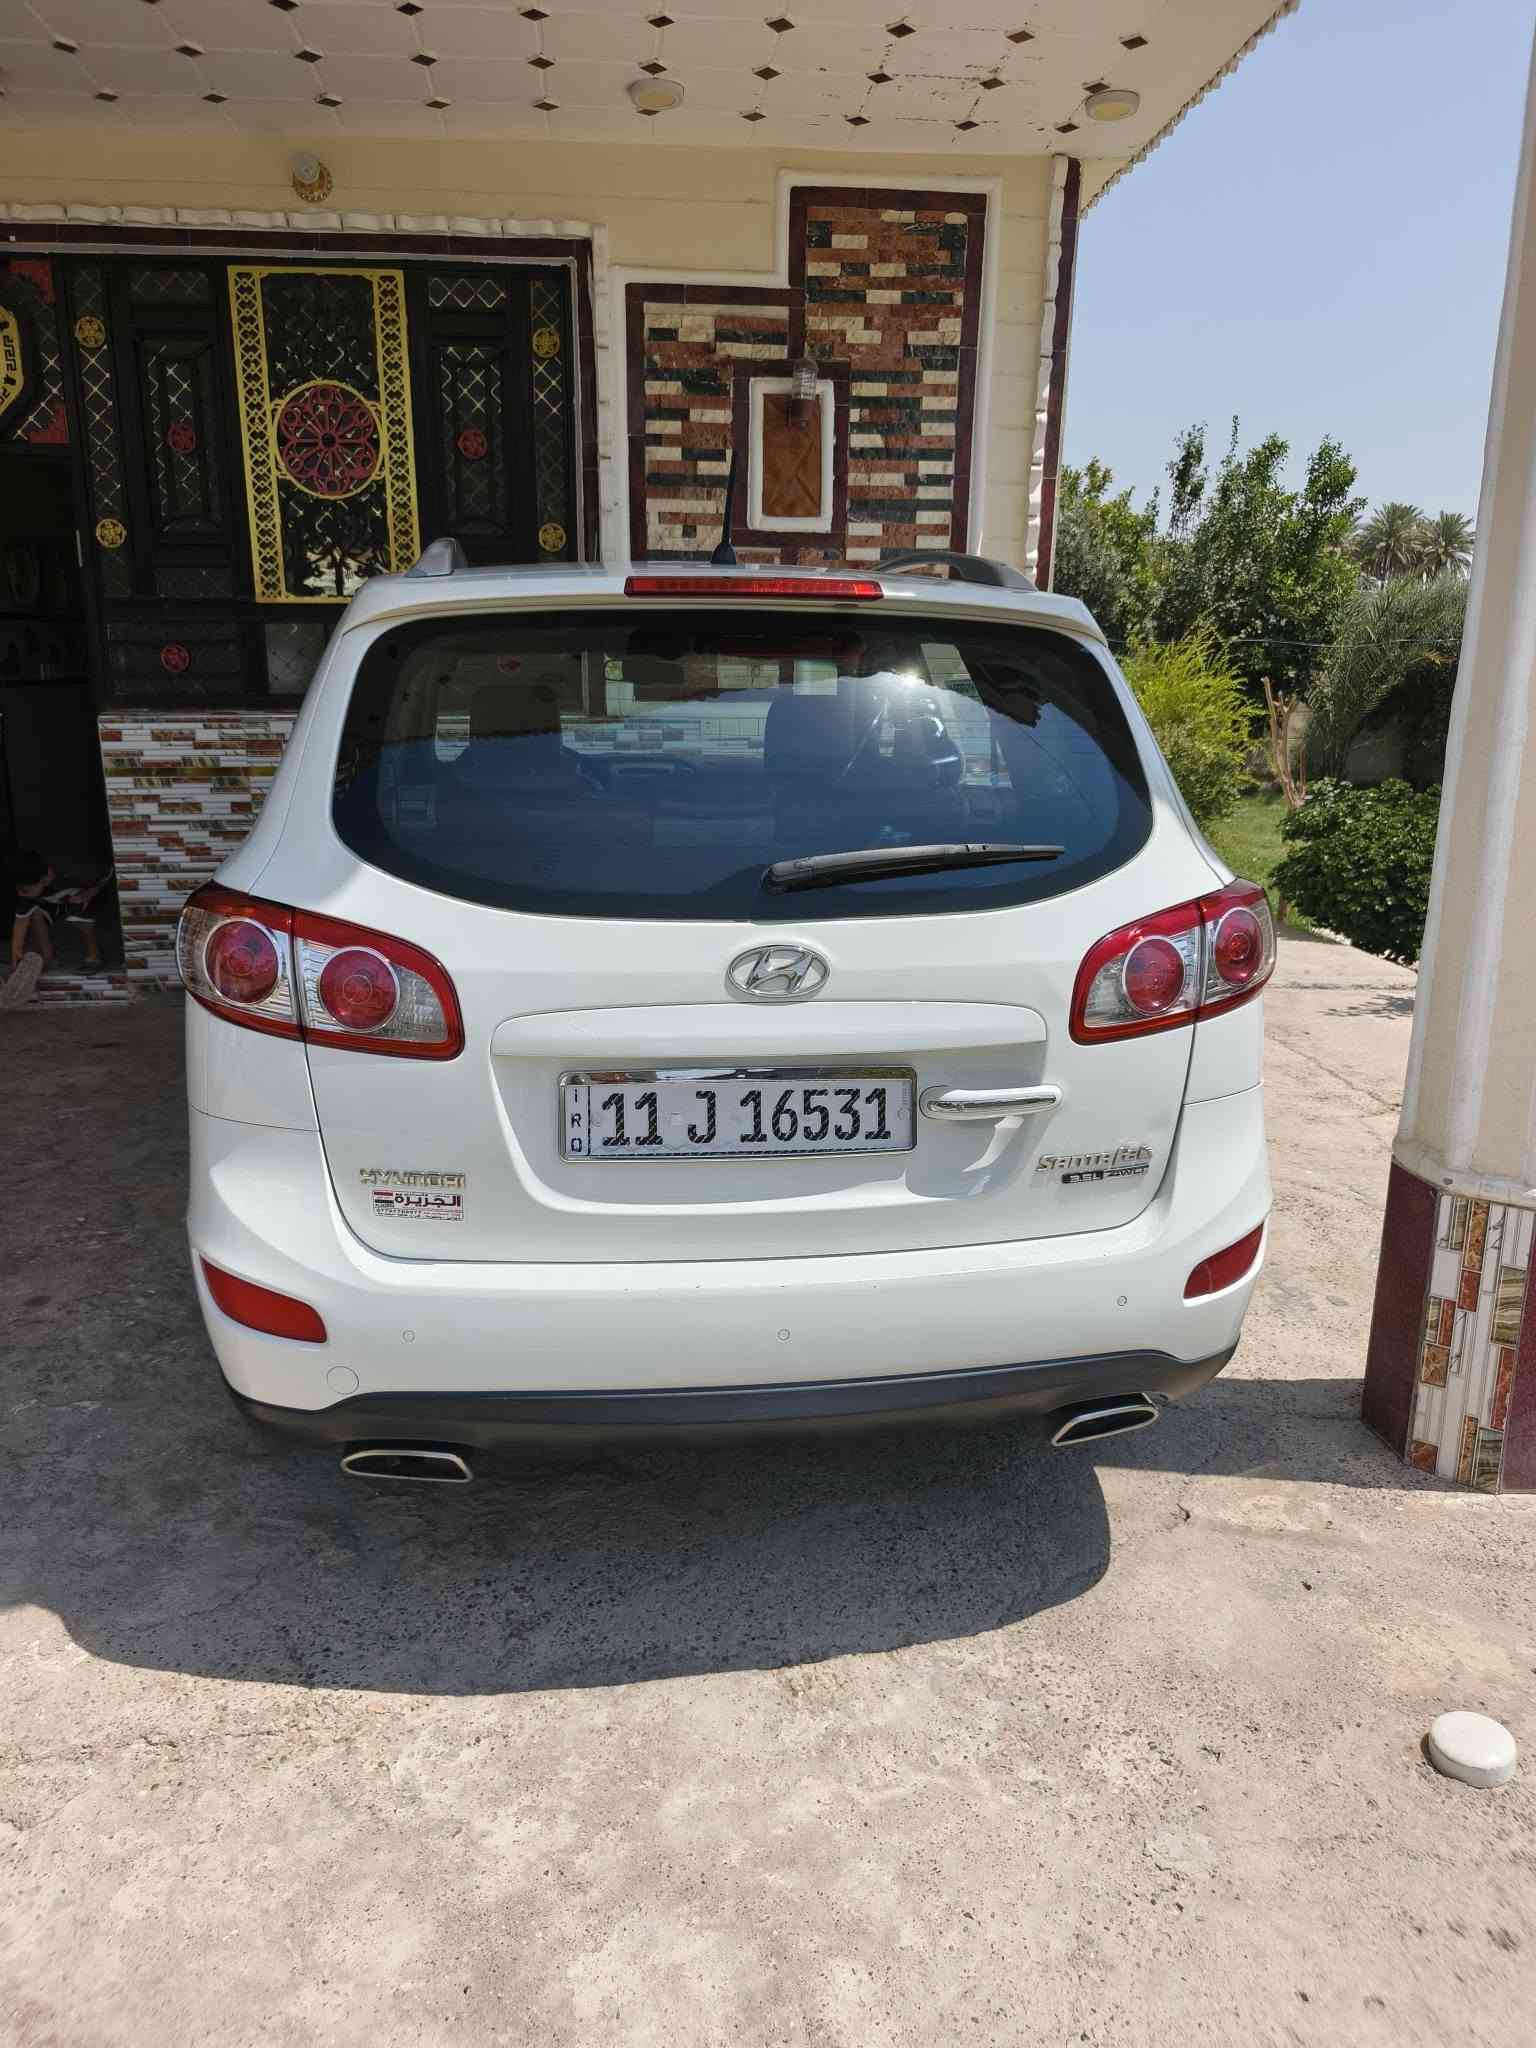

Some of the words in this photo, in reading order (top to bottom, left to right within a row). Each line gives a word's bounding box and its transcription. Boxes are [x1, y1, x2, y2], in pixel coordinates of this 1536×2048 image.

[601, 1092, 663, 1146] 11
[687, 1090, 716, 1143] J
[739, 1087, 891, 1143] 16531
